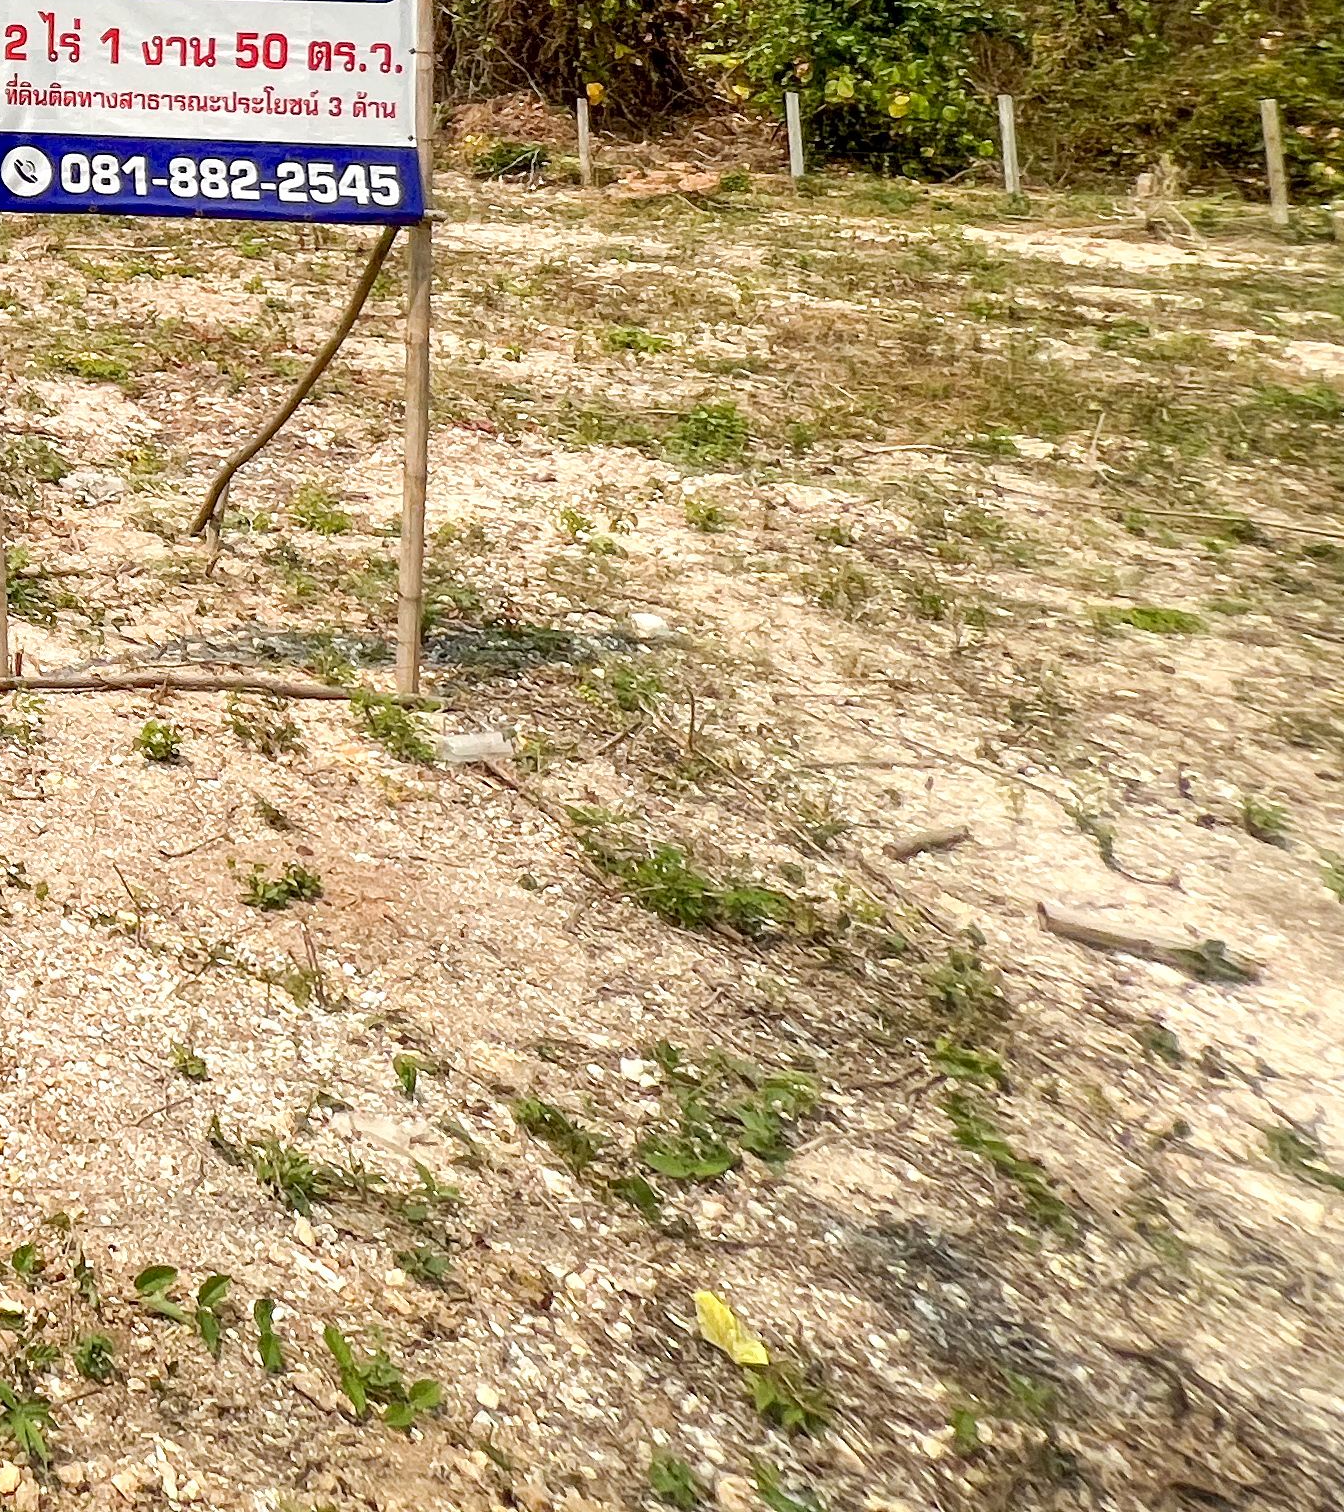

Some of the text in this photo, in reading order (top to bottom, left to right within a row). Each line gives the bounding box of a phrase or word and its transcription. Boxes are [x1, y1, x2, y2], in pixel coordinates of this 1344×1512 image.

[4, 11, 404, 75] 2 ไร่ 1 งาน 50 ตร.ว.
[4, 74, 398, 120] ที่ดินติดทางสาธารณะประโยชน์ 3 ด้าน
[60, 153, 401, 207] 081-882-2545
